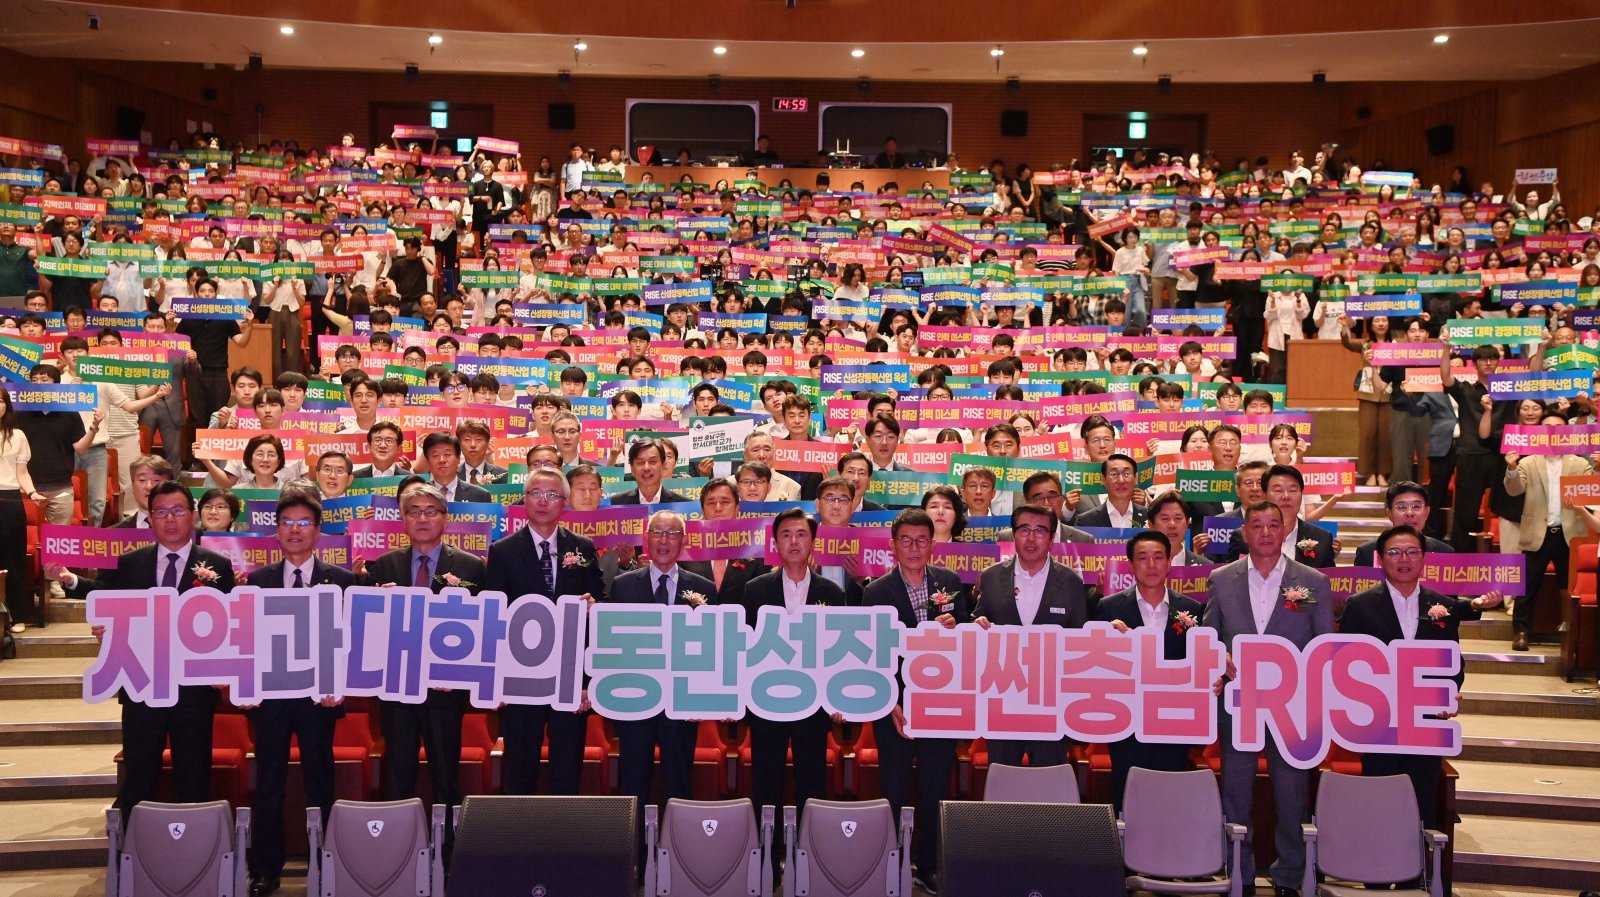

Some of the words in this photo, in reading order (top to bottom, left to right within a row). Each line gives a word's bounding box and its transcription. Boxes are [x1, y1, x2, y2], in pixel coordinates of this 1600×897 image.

[779, 100, 806, 110] 14:59
[44, 200, 73, 210] 지역인재,
[368, 240, 387, 248] 미래의
[90, 247, 106, 255] RISE
[108, 248, 120, 256] 대학
[39, 262, 56, 270] RISE
[58, 263, 71, 271] 대학
[141, 265, 158, 273] RISE
[337, 259, 356, 268] 미래의
[641, 260, 653, 268] RISE
[260, 269, 272, 278] RISE
[973, 267, 984, 276] RISE
[461, 275, 476, 284] RISE
[477, 275, 488, 284] 대학
[538, 278, 553, 287] RISE
[1417, 280, 1432, 288] RISE
[595, 282, 609, 290] RISE
[645, 290, 660, 300] RISE
[661, 287, 698, 298] 신성장동력산업
[921, 292, 934, 302] RISE
[1502, 290, 1517, 299] RISE
[173, 304, 189, 313] RISE
[190, 304, 232, 313] 신성장동력산업
[815, 305, 829, 314] RISE
[1346, 301, 1363, 310] RISE
[515, 308, 530, 317] RISE
[531, 308, 569, 319] 신성장동력산업
[571, 308, 582, 319] 육성
[1153, 314, 1169, 324] RISE
[92, 316, 136, 327] 신성장동력산업
[356, 321, 370, 330] RISE
[700, 317, 714, 327] RISE
[715, 317, 752, 328] 신성장동력산업
[753, 318, 764, 328] 육성
[1574, 316, 1592, 325] RISE
[1450, 326, 1473, 337] RISE
[1475, 327, 1493, 337] 대학
[1494, 326, 1521, 337] 경쟁력
[1523, 326, 1542, 336] 강화
[133, 338, 147, 348] 인력
[592, 336, 604, 345] 인력
[973, 334, 990, 344] RISE
[1031, 334, 1044, 344] 해결
[1051, 333, 1064, 343] 인력
[1066, 333, 1090, 342] 미스매치
[1092, 333, 1106, 342] 해결
[1160, 343, 1177, 353] RISE
[1220, 342, 1234, 353] 해결
[1374, 348, 1392, 358] RISE
[1393, 350, 1407, 358] 인력
[1409, 349, 1436, 359] 미스매치
[364, 357, 391, 368] 미래의
[784, 356, 792, 366] 힘
[80, 363, 102, 375] RISE
[105, 365, 123, 376] 대학
[125, 368, 150, 378] 경쟁력
[152, 368, 169, 379] 강화
[458, 363, 478, 375] RISE
[479, 364, 529, 378] 신성장동력산업
[531, 366, 546, 377] 육성
[970, 364, 978, 373] 힘
[1040, 362, 1047, 372] 힘
[824, 372, 842, 383] RISE
[844, 372, 892, 384] 신성장동력산업
[894, 373, 907, 383] 육성
[1108, 383, 1129, 392] RISE
[1491, 380, 1512, 392] RISE
[1515, 380, 1571, 391] 신성장동력산업
[1573, 378, 1590, 390] 육성
[18, 391, 76, 403] 신성장동력산업
[78, 392, 94, 403] 육성
[326, 390, 342, 400] 대학
[602, 387, 619, 399] RISE
[735, 389, 751, 402] 육성
[588, 406, 604, 416] 육성
[1043, 405, 1064, 417] RISE
[1066, 404, 1082, 415] 인력
[1085, 401, 1116, 414] 미스매치
[1118, 399, 1134, 411] 해결
[830, 408, 849, 419] RISE
[851, 409, 867, 420] 인력
[902, 409, 917, 420] 해결
[920, 409, 933, 420] 인력
[963, 408, 984, 419] RISE
[986, 409, 1002, 420] 인력
[238, 417, 261, 429] RISE
[283, 420, 317, 431] 미스매치
[319, 422, 337, 433] 해결
[403, 415, 452, 429] 지역인재,
[493, 418, 505, 430] 힘
[509, 414, 526, 426] 해결
[1127, 422, 1149, 433] RISE
[1151, 421, 1167, 432] 인력
[1240, 423, 1257, 435] 인력
[1296, 422, 1310, 435] 해결
[296, 439, 305, 450] 힘
[1505, 433, 1528, 446] RISE
[1530, 434, 1549, 445] 인력
[1551, 434, 1589, 445] 미스매치
[402, 441, 413, 453] 힘
[583, 439, 594, 452] 힘
[1021, 444, 1054, 457] 미래의
[1058, 441, 1069, 454] 힘
[804, 447, 837, 464] 미래의
[914, 450, 947, 466] 미래의
[1133, 447, 1144, 458] 힘
[1304, 472, 1337, 485] 미래의
[1341, 472, 1352, 484] 힘
[890, 480, 920, 495] 경쟁력
[1179, 479, 1208, 492] RISE
[1210, 479, 1233, 492] 대학
[252, 512, 277, 525] RISE
[375, 507, 400, 521] RISE
[572, 521, 618, 536] 미스매치
[621, 519, 643, 534] 해결
[354, 532, 385, 548] RISE
[464, 534, 487, 550] 해결
[706, 532, 751, 548] 미스매치
[46, 538, 80, 555] RISE
[83, 539, 107, 557] 인력
[242, 549, 267, 565] 인력
[322, 548, 347, 564] 해결
[864, 549, 894, 565] RISE
[1443, 566, 1491, 583] 미스매치
[1495, 566, 1520, 583] 해결
[92, 593, 343, 699] 지역과
[346, 594, 580, 704] 대학의
[592, 611, 899, 713] 동반성장
[907, 629, 1219, 736] 힘쎈충남
[1233, 641, 1453, 760] RISE
